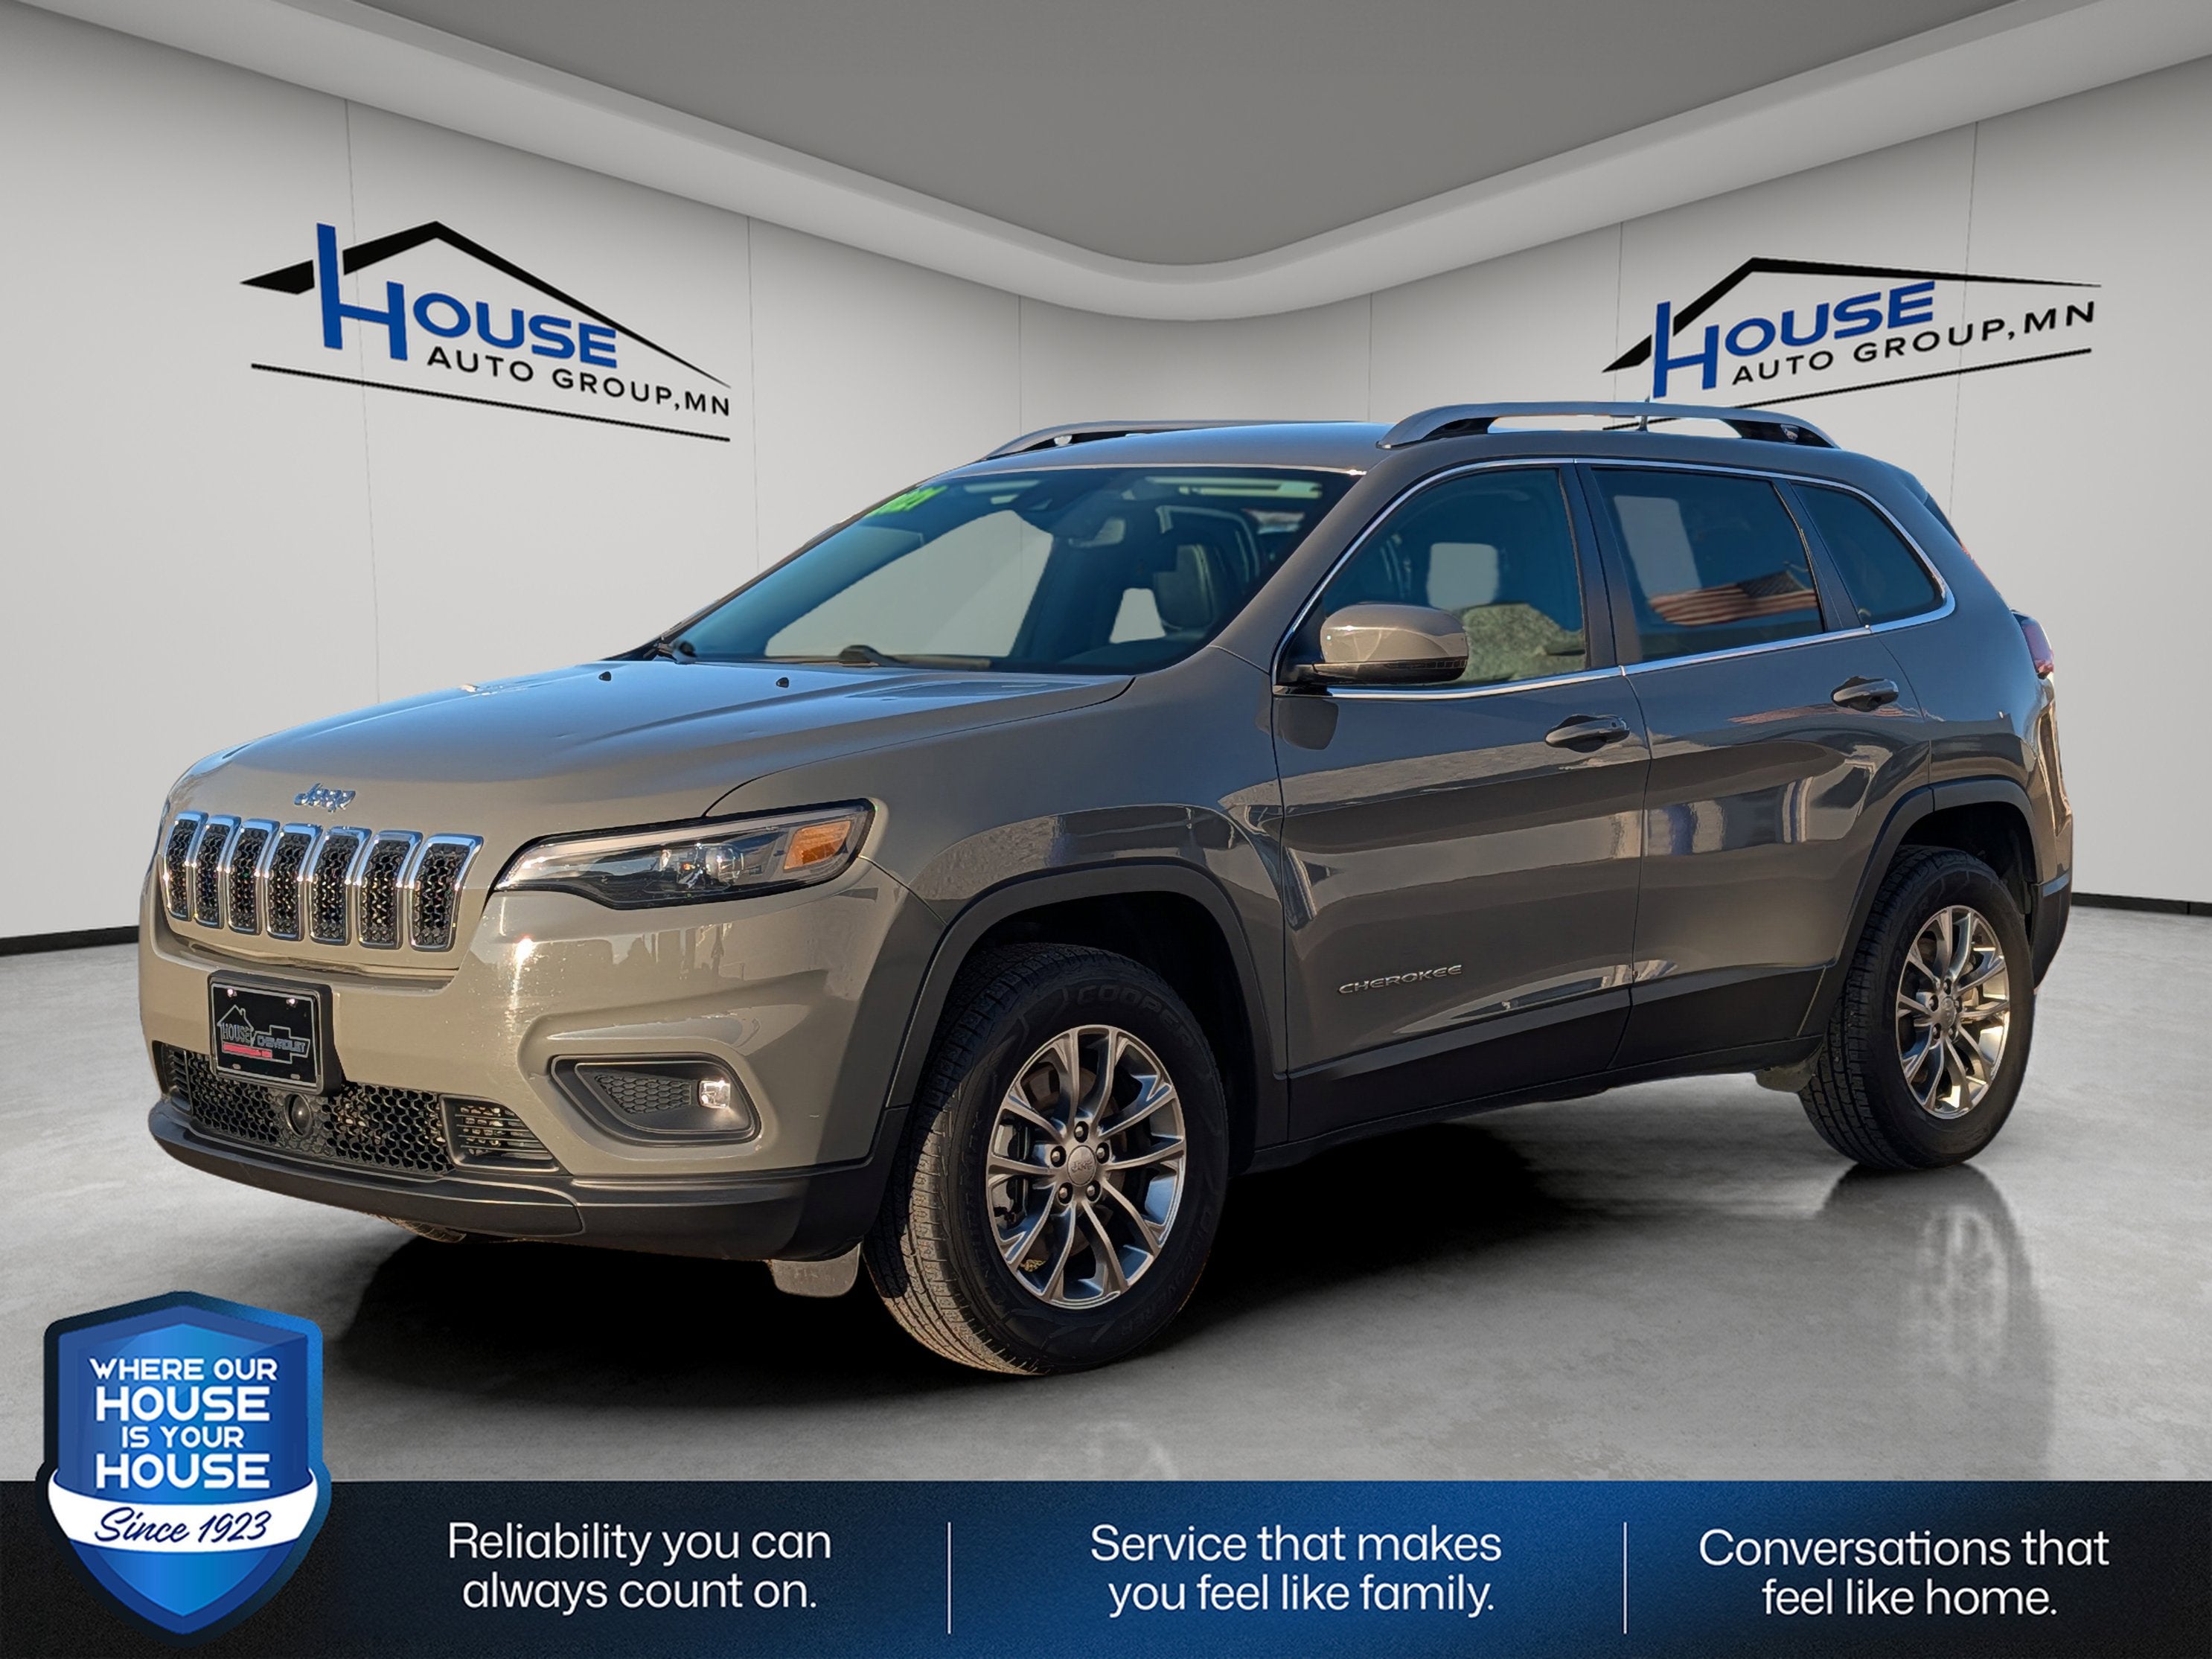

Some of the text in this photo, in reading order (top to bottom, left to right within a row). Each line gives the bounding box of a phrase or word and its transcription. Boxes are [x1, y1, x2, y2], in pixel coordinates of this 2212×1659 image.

[316, 223, 617, 368] HOUSE
[1652, 281, 1935, 398] HOUSE
[427, 346, 534, 382] AUTO
[1732, 351, 1834, 385] AUTO
[1337, 964, 1462, 994] CHEROKEE
[223, 1023, 252, 1044] HOUSE
